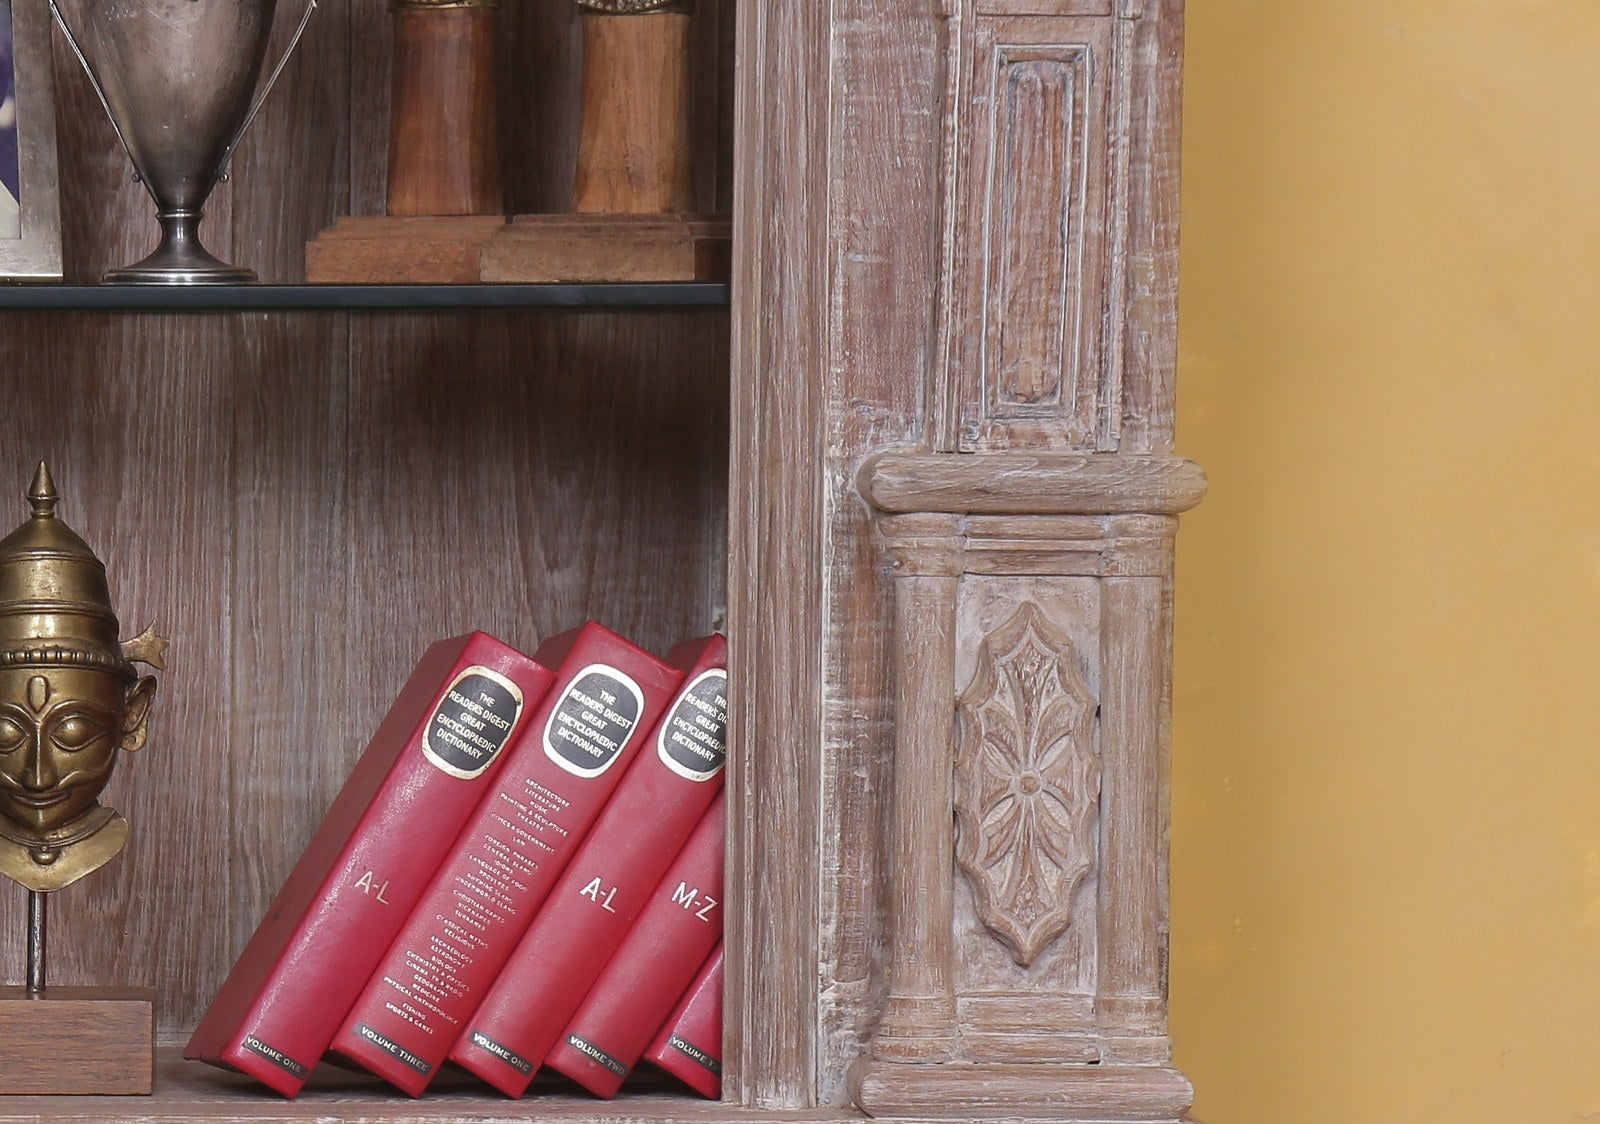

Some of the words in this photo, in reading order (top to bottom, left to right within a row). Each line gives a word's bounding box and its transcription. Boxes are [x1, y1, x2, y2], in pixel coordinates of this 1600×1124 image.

[477, 692, 496, 708] THE
[597, 689, 616, 705] THE
[459, 711, 486, 732] GREAT
[481, 709, 510, 731] DIGEST
[556, 711, 618, 751] ENCYCLOPAEDIC
[580, 710, 607, 730] GREAT
[603, 707, 632, 729] DIGEST
[694, 714, 720, 734] GREAT
[435, 713, 497, 753] ENCYCLOPAEDIC
[435, 727, 483, 760] DICTIONARY
[556, 726, 604, 758] DICTIONARY
[671, 731, 716, 762] DICTIONARY
[524, 787, 560, 812] LITERATURE
[525, 778, 570, 807] ARCHITECTURE
[528, 799, 548, 814] MUSIC
[499, 792, 527, 812] PAINTING
[533, 812, 568, 836] SCULPTURE
[515, 811, 544, 831] THEATRE
[482, 842, 511, 863] GENERAL
[353, 867, 398, 906] A-L
[578, 873, 625, 913] A-L
[669, 880, 719, 922] M-Z
[430, 955, 457, 974] BIOLOGY
[411, 982, 440, 1003] MEDICINE
[385, 1002, 408, 1019] SPORTS
[413, 1019, 434, 1035] GAMES
[401, 1002, 426, 1020] FISHING
[245, 1036, 282, 1061] VOLUME
[281, 1056, 302, 1073] ONE
[359, 1026, 398, 1053] VOLUME
[397, 1048, 428, 1072] THREE
[471, 1032, 510, 1059] VOLUME
[509, 1055, 530, 1072] ONE
[568, 1035, 607, 1063] VOLUME
[605, 1059, 625, 1076] TWO
[670, 1036, 708, 1064] VOLUME
